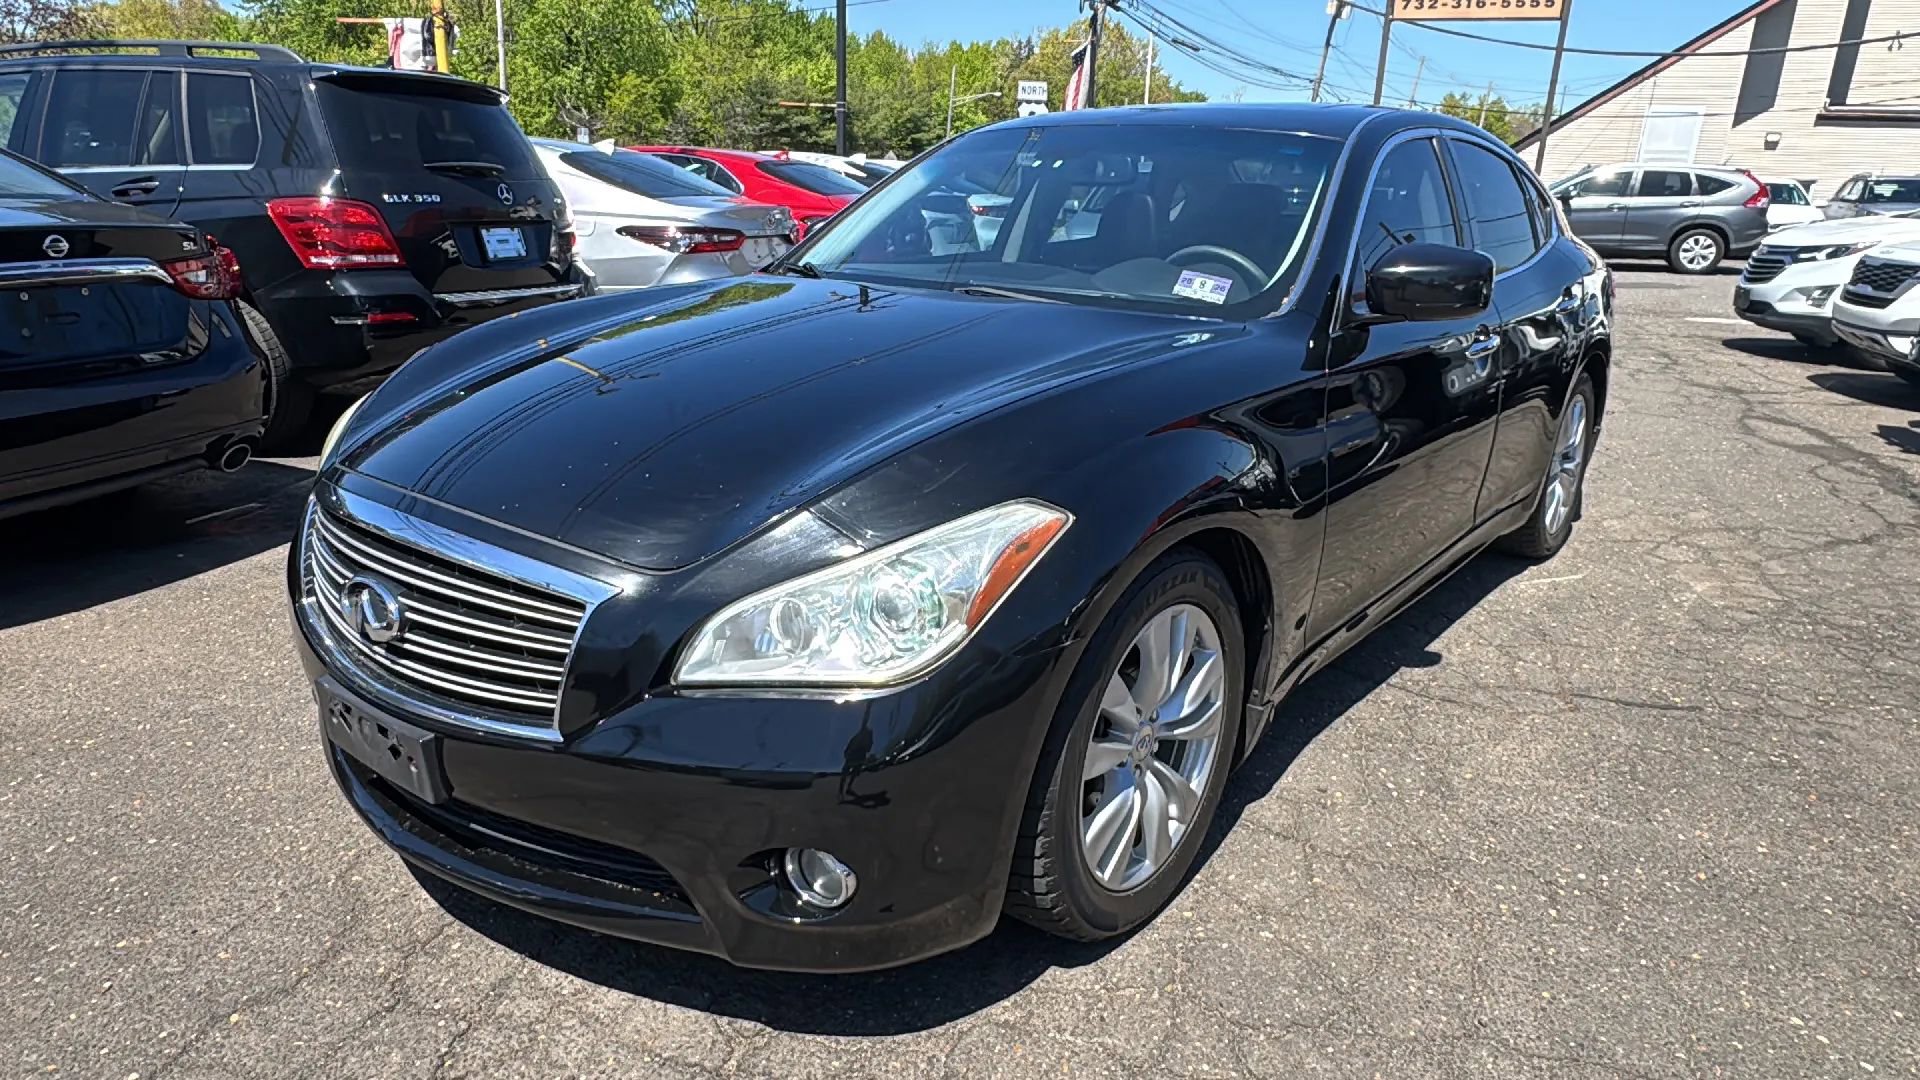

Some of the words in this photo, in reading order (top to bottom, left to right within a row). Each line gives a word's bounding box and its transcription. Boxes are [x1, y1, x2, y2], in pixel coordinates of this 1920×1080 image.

[1401, 0, 1556, 10] 732-316-5555
[1021, 85, 1047, 96] NORTH
[383, 194, 412, 203] GLK
[414, 194, 441, 203] 350
[182, 241, 198, 250] SL
[1199, 279, 1207, 290] 8
